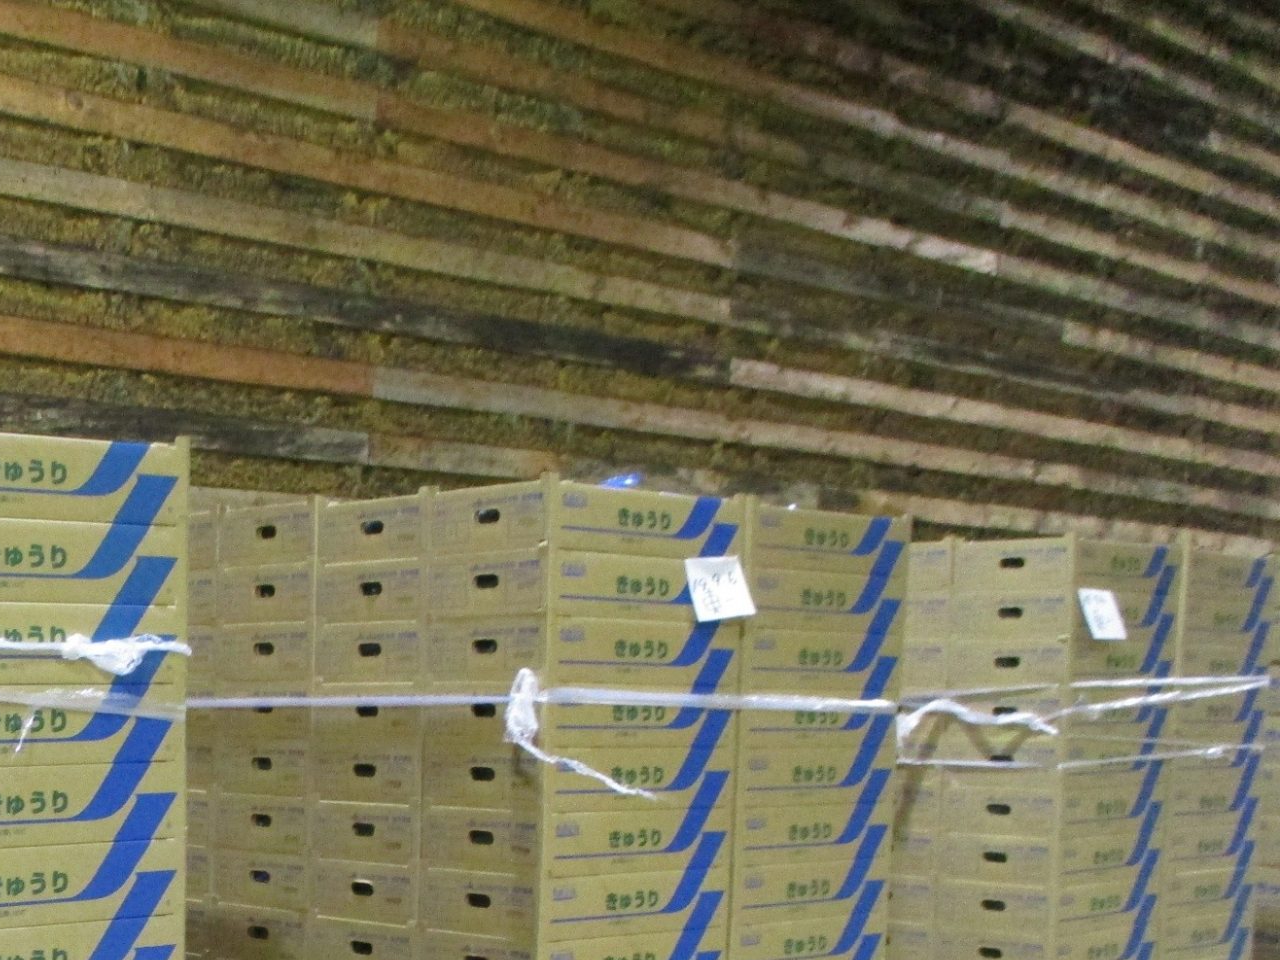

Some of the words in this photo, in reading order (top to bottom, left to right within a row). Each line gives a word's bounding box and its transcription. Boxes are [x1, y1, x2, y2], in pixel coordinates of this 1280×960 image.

[618, 507, 672, 530] きゅうり
[616, 575, 670, 596] きゅうり
[614, 639, 668, 659] きゅうり
[611, 766, 664, 785] きゅうり
[608, 826, 662, 849] きゅうり
[605, 891, 659, 911] きゅうり
